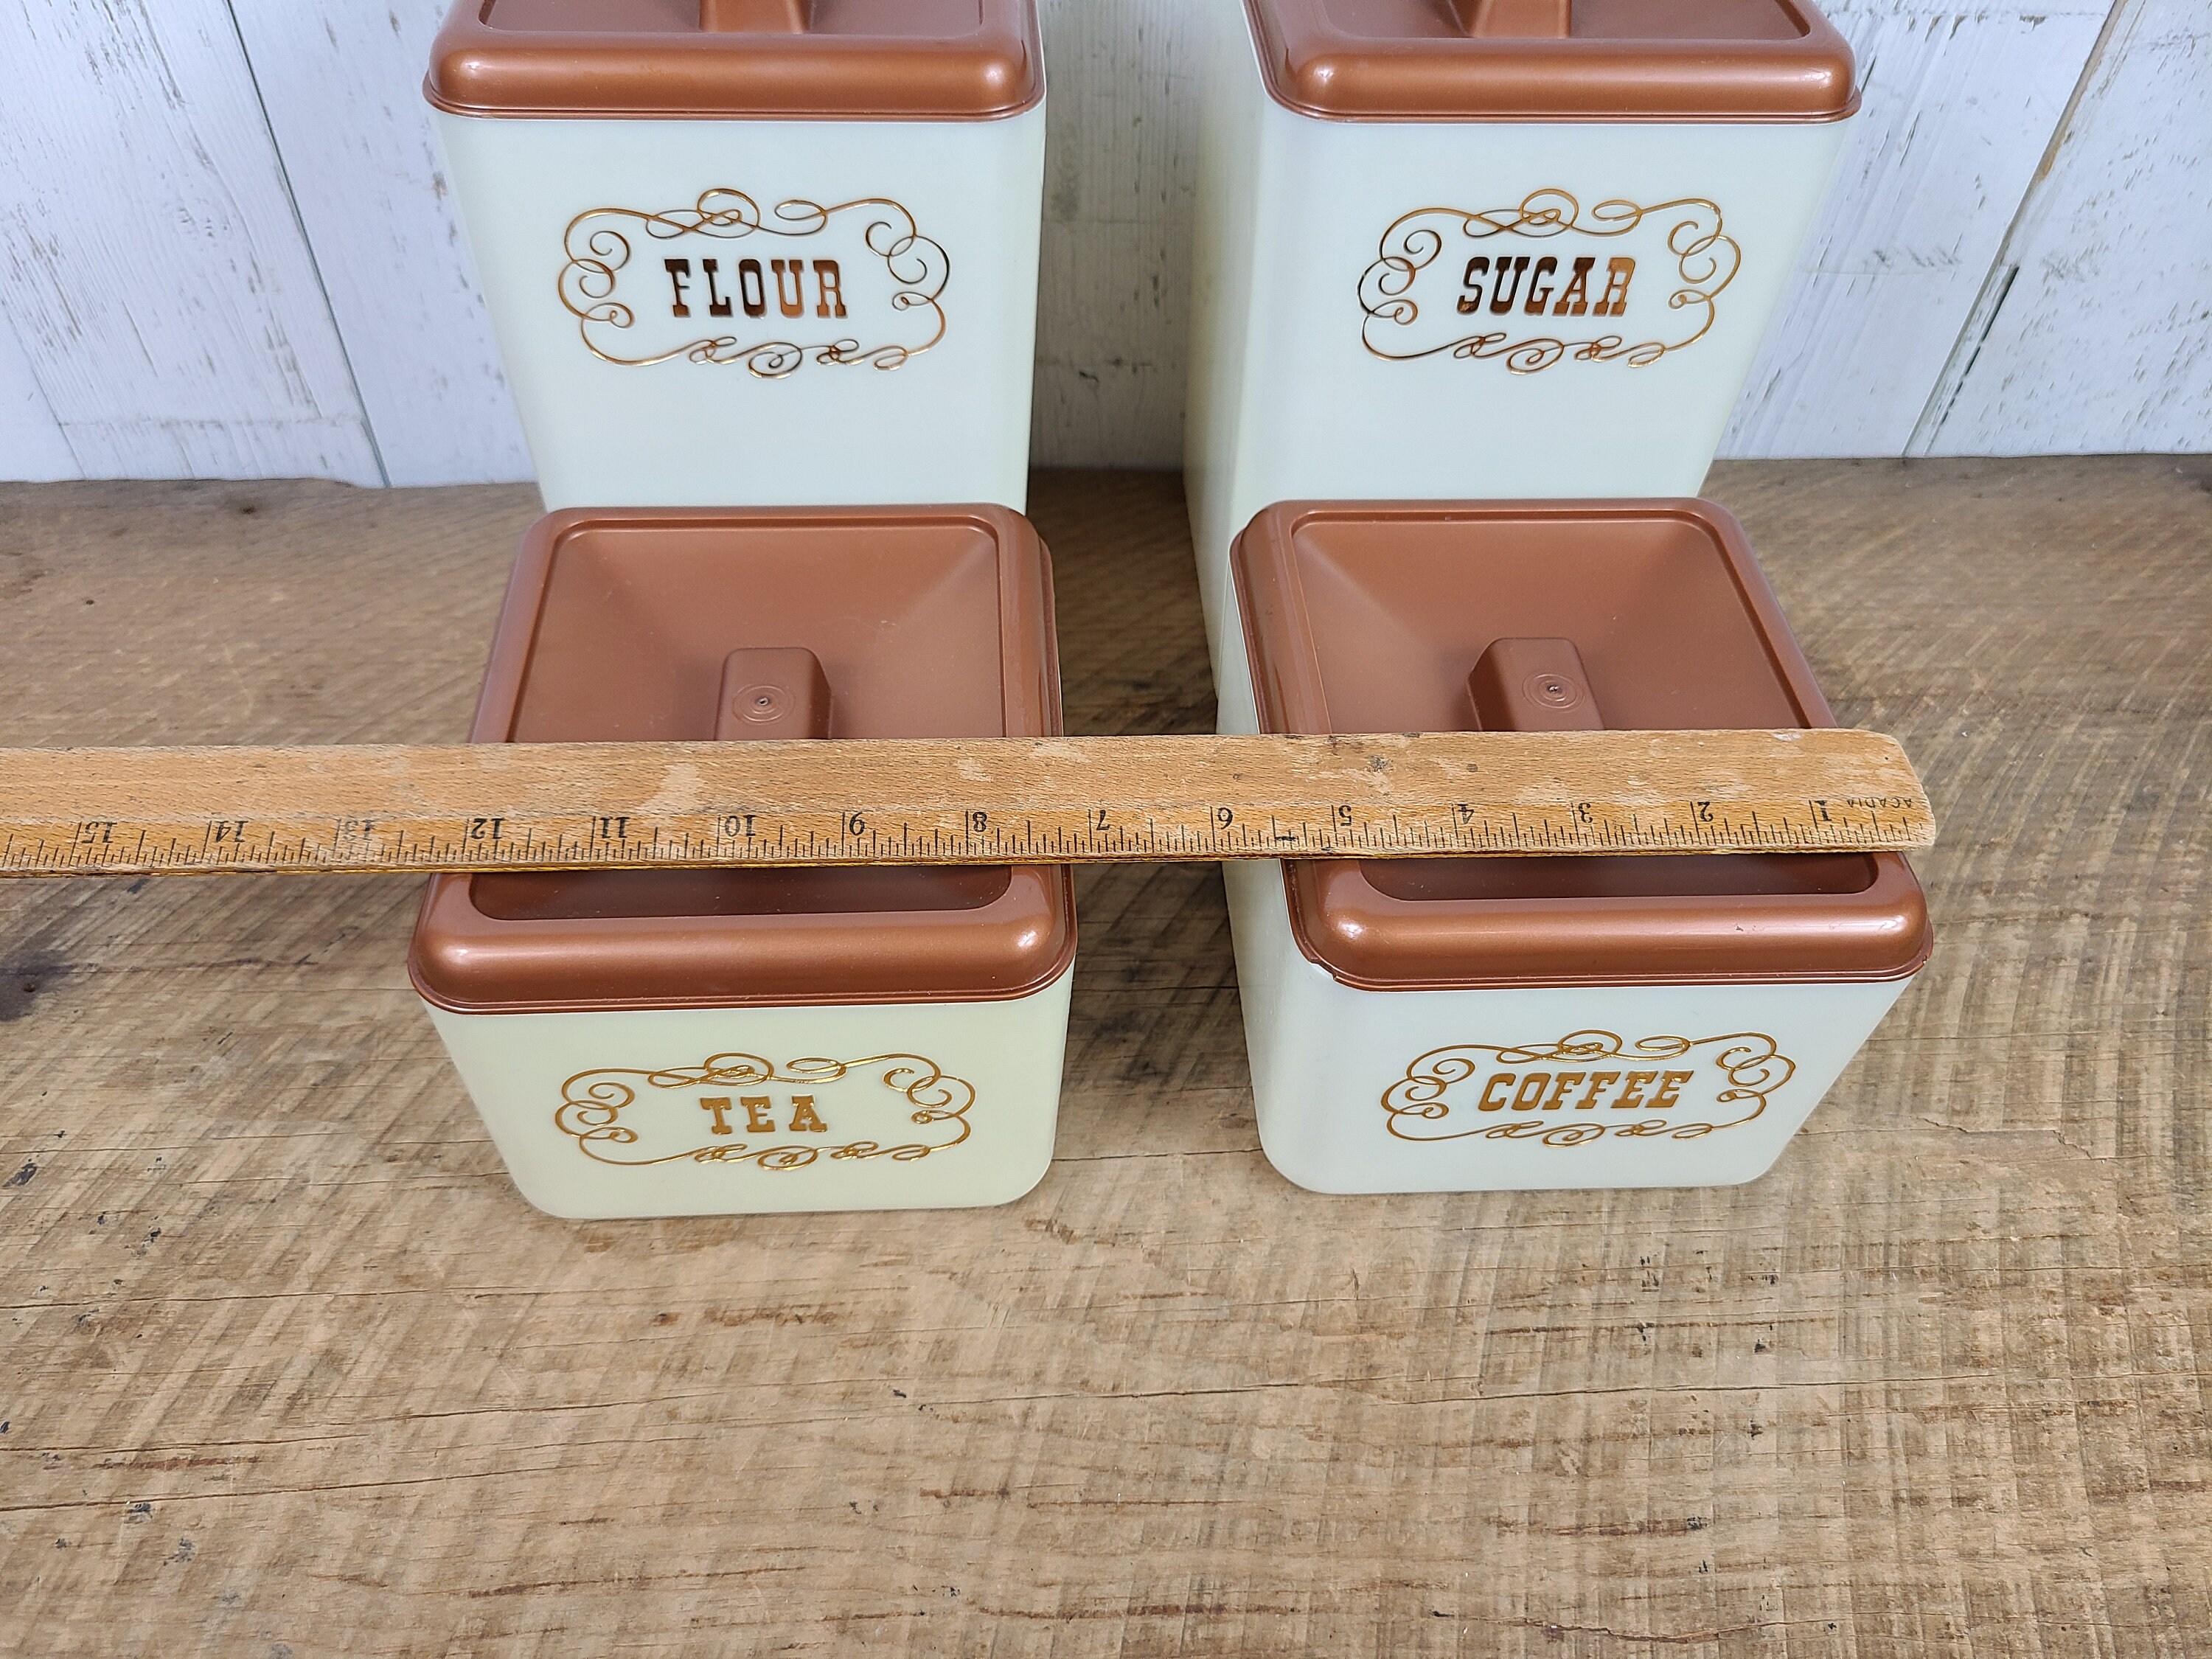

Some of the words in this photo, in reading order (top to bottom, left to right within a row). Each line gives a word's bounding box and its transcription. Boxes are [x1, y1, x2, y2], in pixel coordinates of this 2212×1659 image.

[664, 258, 847, 319] FLOUR
[1456, 256, 1636, 317] SUGAR
[1458, 804, 1475, 824] 4
[1578, 802, 1593, 824] 3
[1697, 801, 1714, 821] 2
[1815, 800, 1832, 821] 1
[1846, 797, 1913, 809] ACADIA
[599, 816, 631, 838] 11
[724, 815, 757, 836] 10
[849, 811, 865, 835] 9
[972, 811, 988, 832] 8
[1096, 810, 1110, 831] 7
[1217, 807, 1234, 830] 6
[1338, 805, 1352, 827] 5
[81, 821, 117, 844] 15
[215, 820, 248, 843] 14
[344, 818, 376, 841] 13
[470, 818, 506, 840] 12
[1478, 1070, 1694, 1111] COFFEE
[700, 1094, 829, 1135] TEA
